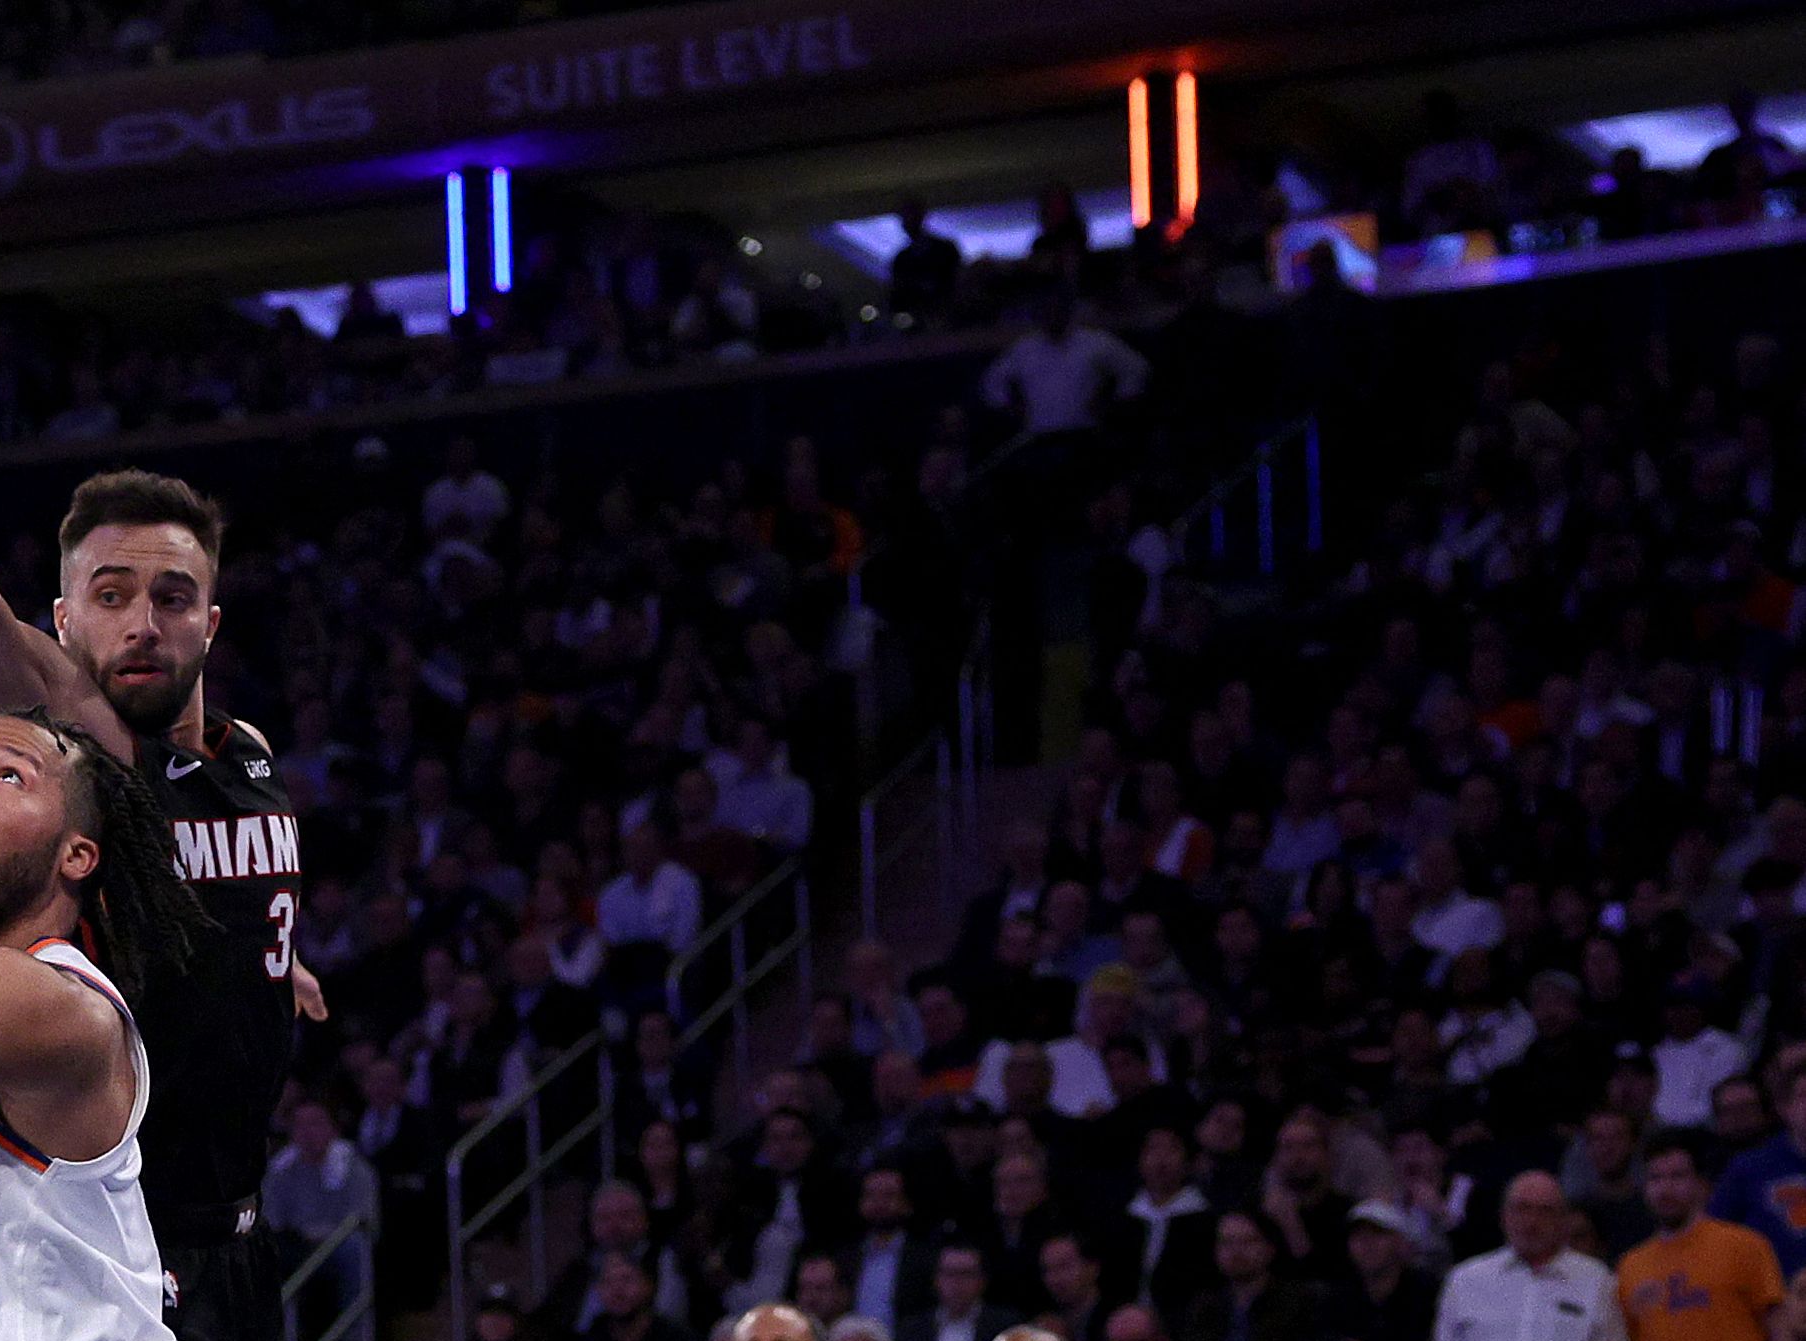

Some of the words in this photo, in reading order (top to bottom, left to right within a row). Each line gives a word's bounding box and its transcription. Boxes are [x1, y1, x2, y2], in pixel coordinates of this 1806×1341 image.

[40, 84, 377, 172] LEXUS
[486, 43, 659, 121] SUITE
[681, 14, 872, 92] LEVEL
[173, 814, 300, 880] MIAM
